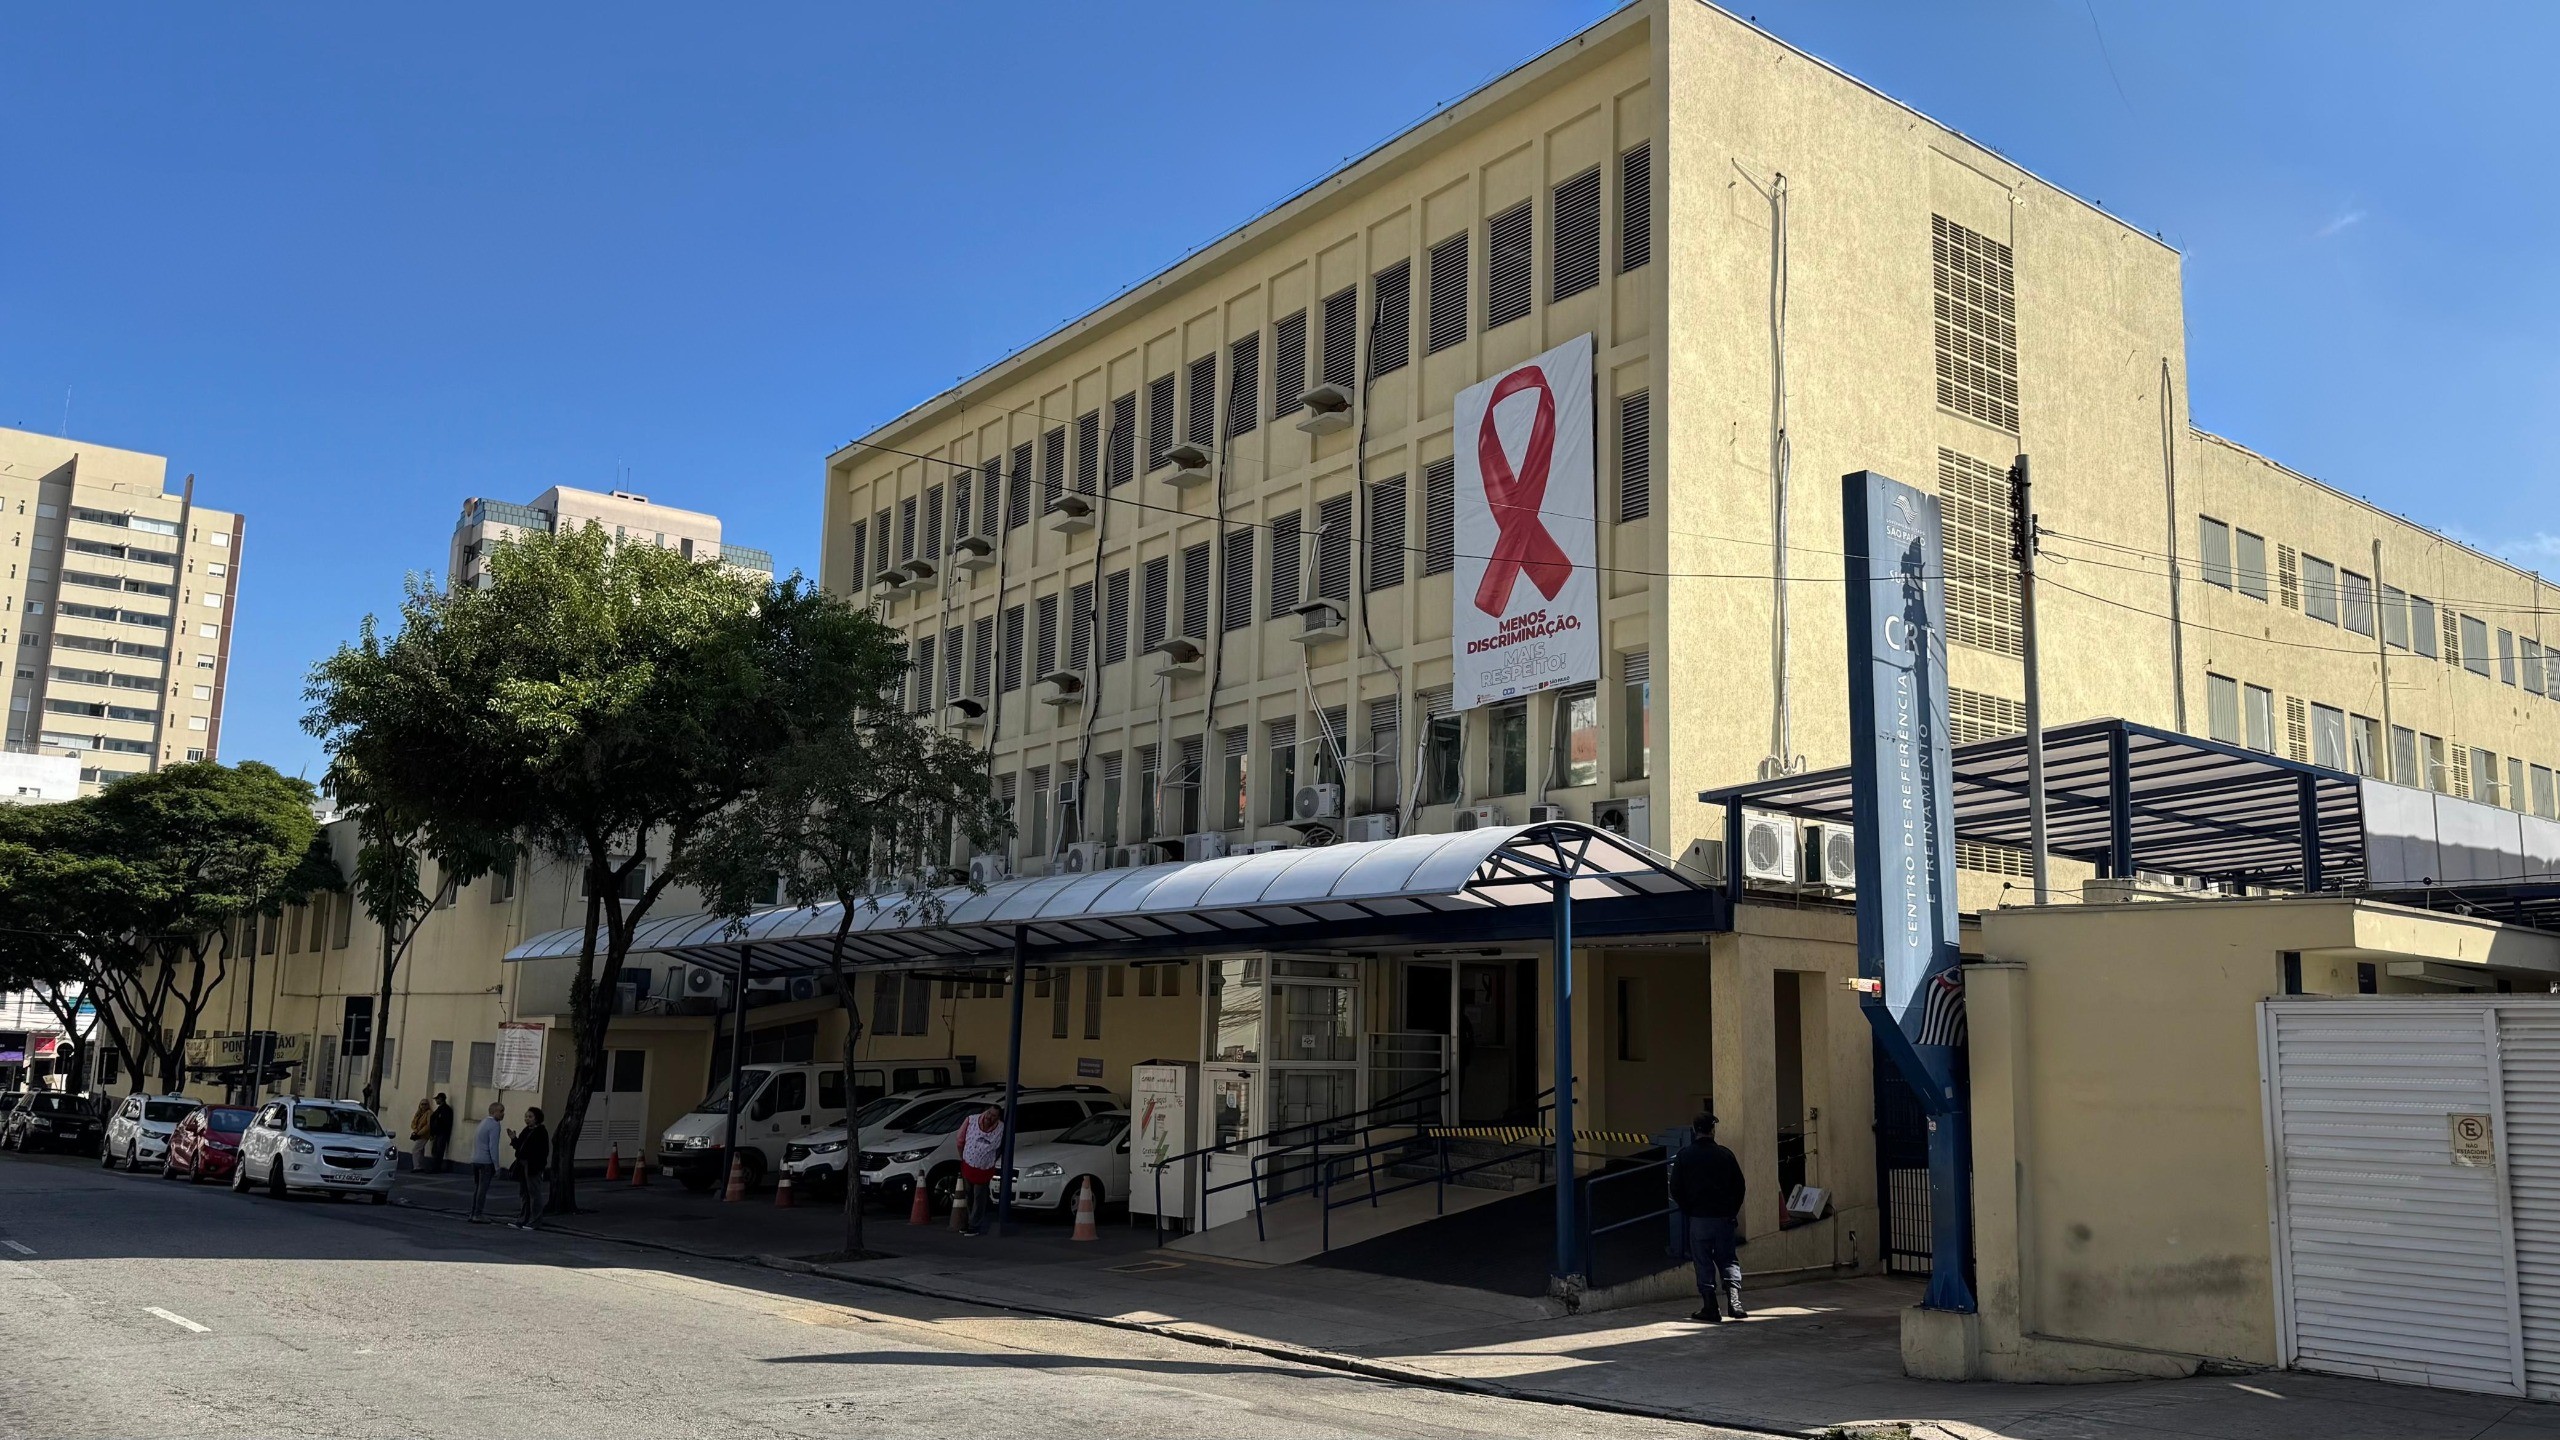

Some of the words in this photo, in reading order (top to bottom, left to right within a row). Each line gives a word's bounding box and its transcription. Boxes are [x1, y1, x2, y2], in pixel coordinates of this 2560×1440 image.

[1902, 531, 1926, 547] PAULO
[1467, 615, 1581, 654] DISCRIMINAÇÃO,
[1499, 609, 1547, 634] MENOS
[1884, 615, 1935, 660] CRT
[1504, 642, 1546, 667] MAIS
[1481, 653, 1566, 688] RESPEITO!
[1897, 675, 1912, 810] REFERÊNCIA
[1919, 724, 1935, 885] TREINAMENTO
[1903, 819, 1914, 847] DE
[1905, 856, 1919, 947] CENTRO
[1926, 894, 1936, 904] E
[222, 1040, 246, 1053] PON
[276, 1034, 295, 1049] ÁXI
